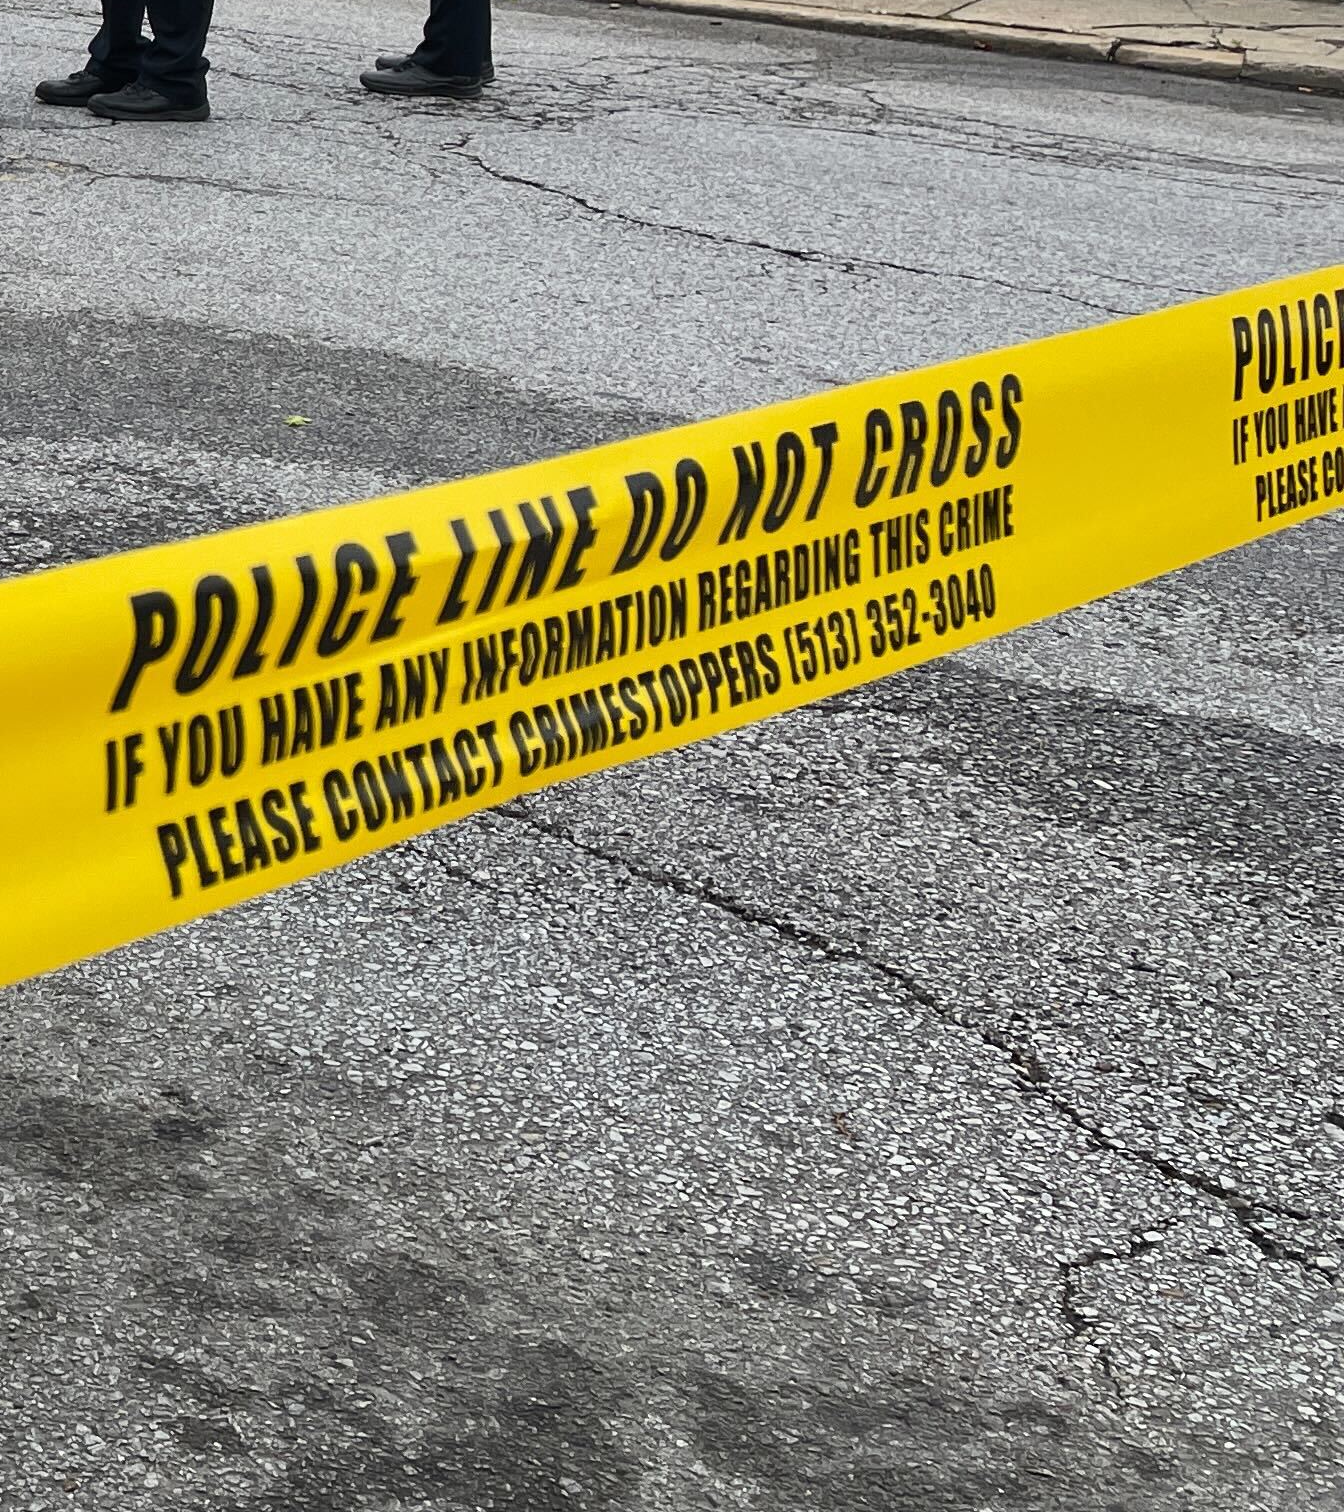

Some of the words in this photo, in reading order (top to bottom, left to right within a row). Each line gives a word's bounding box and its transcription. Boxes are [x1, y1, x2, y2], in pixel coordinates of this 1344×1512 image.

[108, 530, 418, 715] POLICE
[436, 485, 599, 626] LINE
[611, 457, 709, 575] DO
[717, 421, 840, 546] NOT
[853, 373, 1024, 509] CROSS
[1232, 414, 1249, 466] IF
[1253, 402, 1290, 458] YOU
[1294, 386, 1339, 445] HAVE
[1254, 455, 1319, 523] PLEASE
[104, 732, 146, 813] IF
[157, 704, 246, 795] YOU
[258, 671, 365, 767] HAVE
[374, 646, 451, 732] ANY
[460, 577, 688, 706] INFORMATION
[697, 527, 861, 633] REGARDING
[868, 507, 932, 579] THIS
[938, 483, 1016, 558] CRIME
[155, 780, 323, 899] PLEASE
[321, 719, 504, 843] CONTACT
[508, 632, 782, 778] CRIMESTOPPERS
[785, 607, 863, 687] (513)
[865, 562, 998, 659] 352-3040
